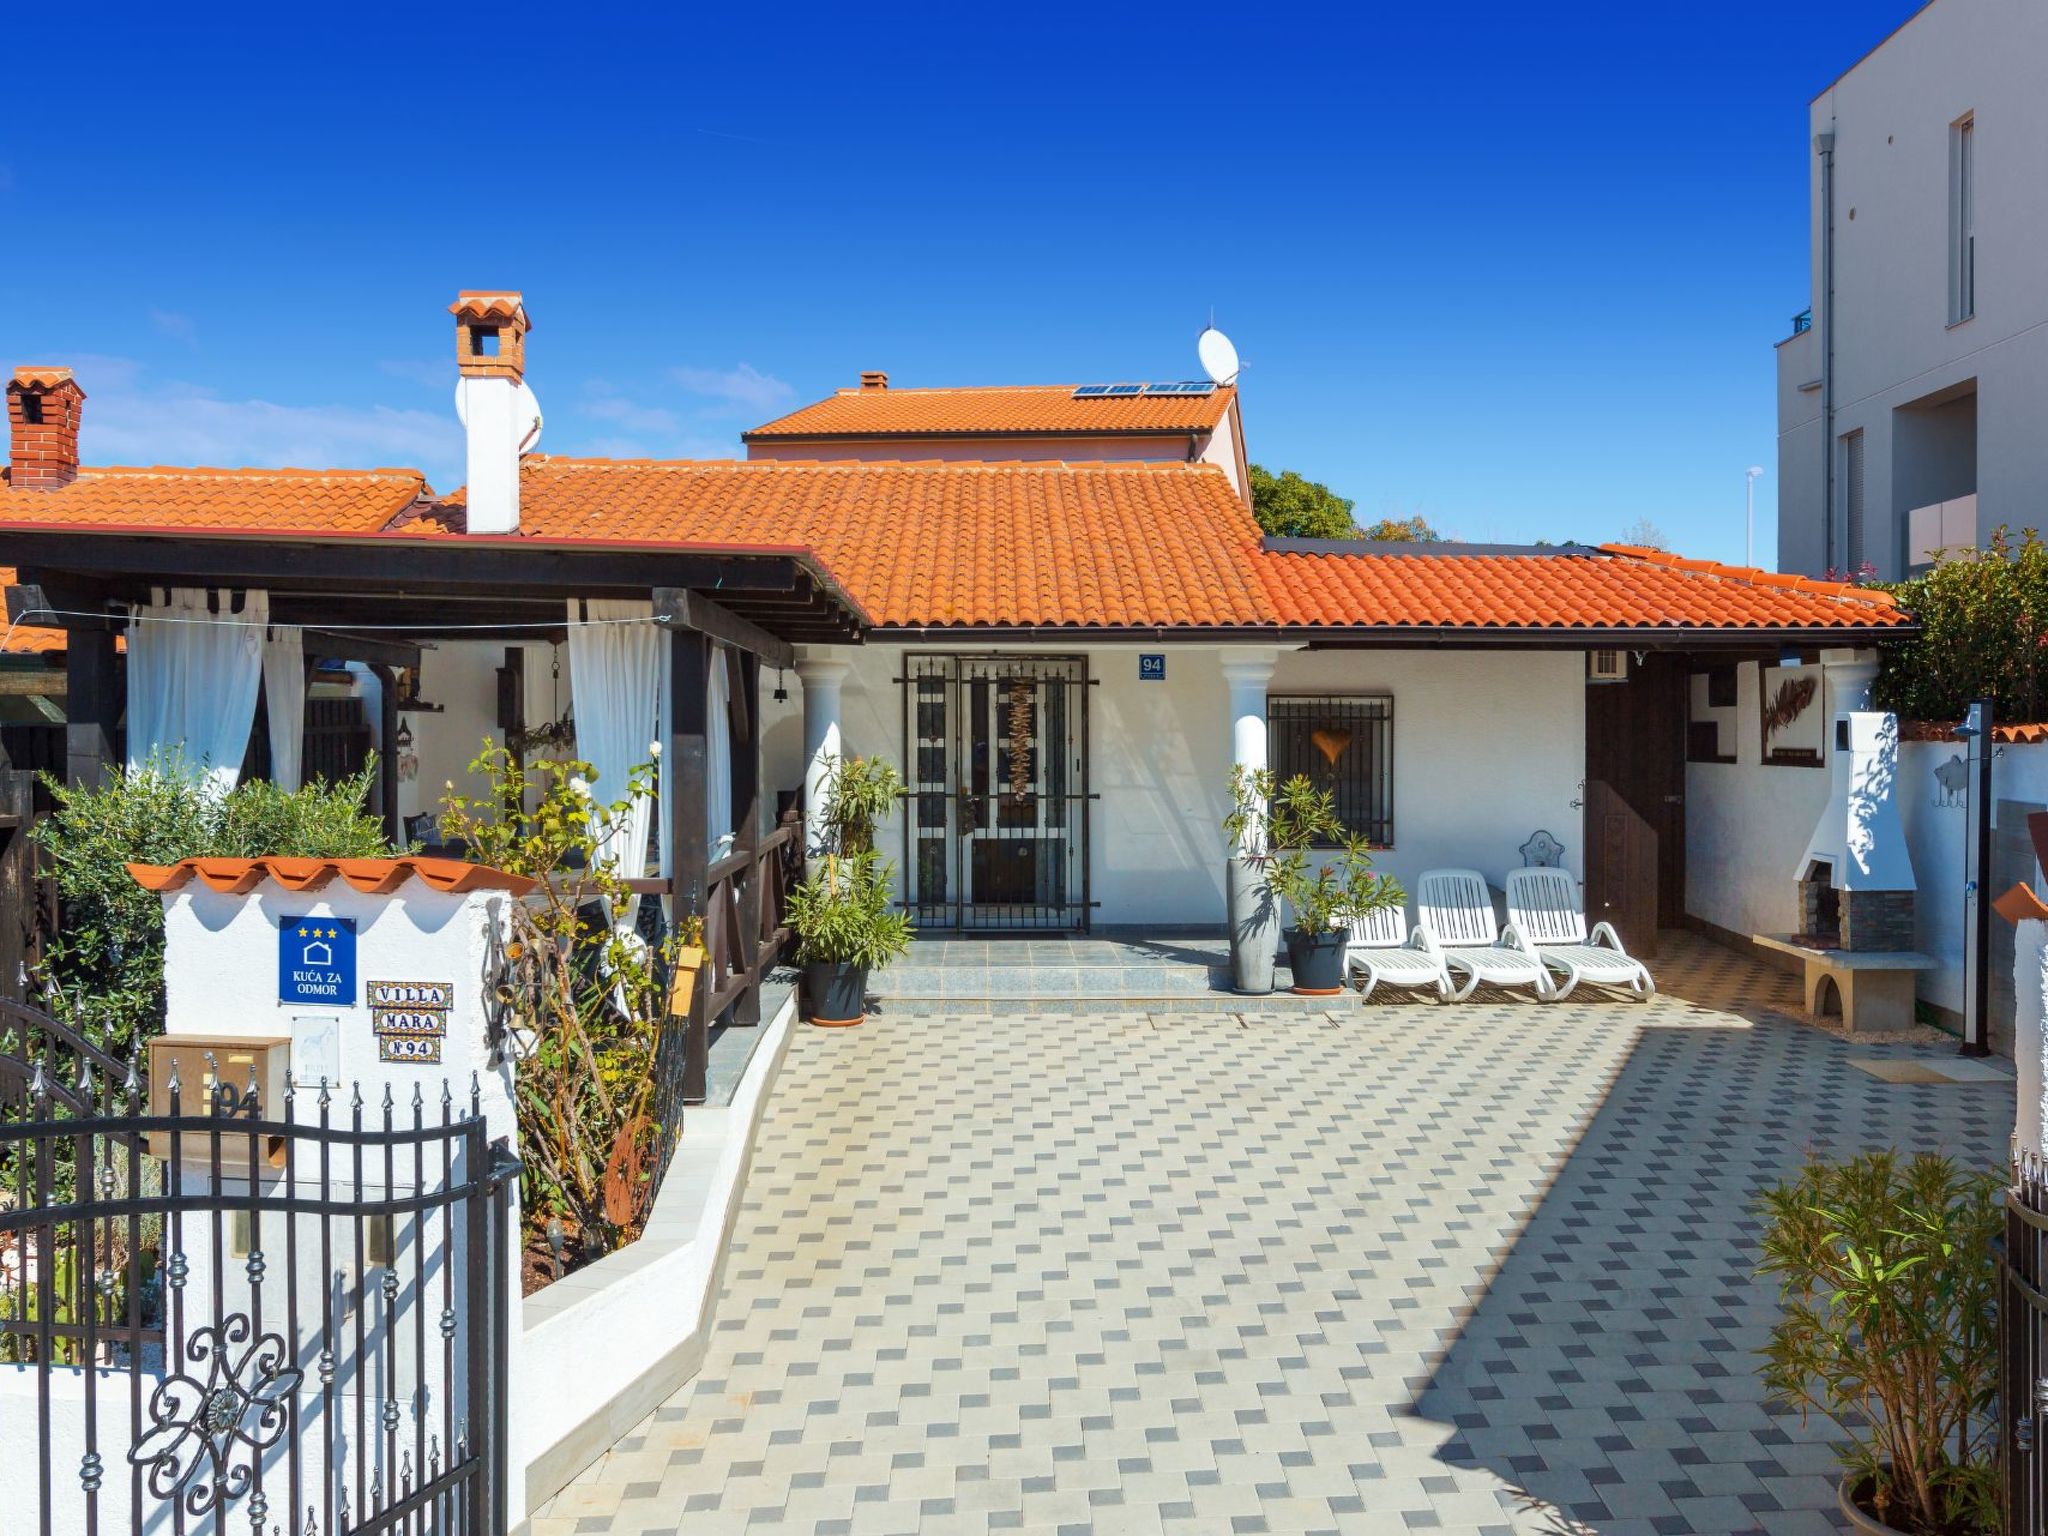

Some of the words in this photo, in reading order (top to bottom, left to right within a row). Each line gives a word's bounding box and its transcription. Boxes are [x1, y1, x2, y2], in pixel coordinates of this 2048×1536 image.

[1143, 658, 1161, 671] 94
[293, 970, 323, 983] KUĆA
[326, 972, 342, 983] ZA
[297, 983, 337, 995] ODMOR
[380, 988, 440, 1002] VILLA
[386, 1014, 434, 1028] MARA
[218, 1081, 262, 1119] 94
